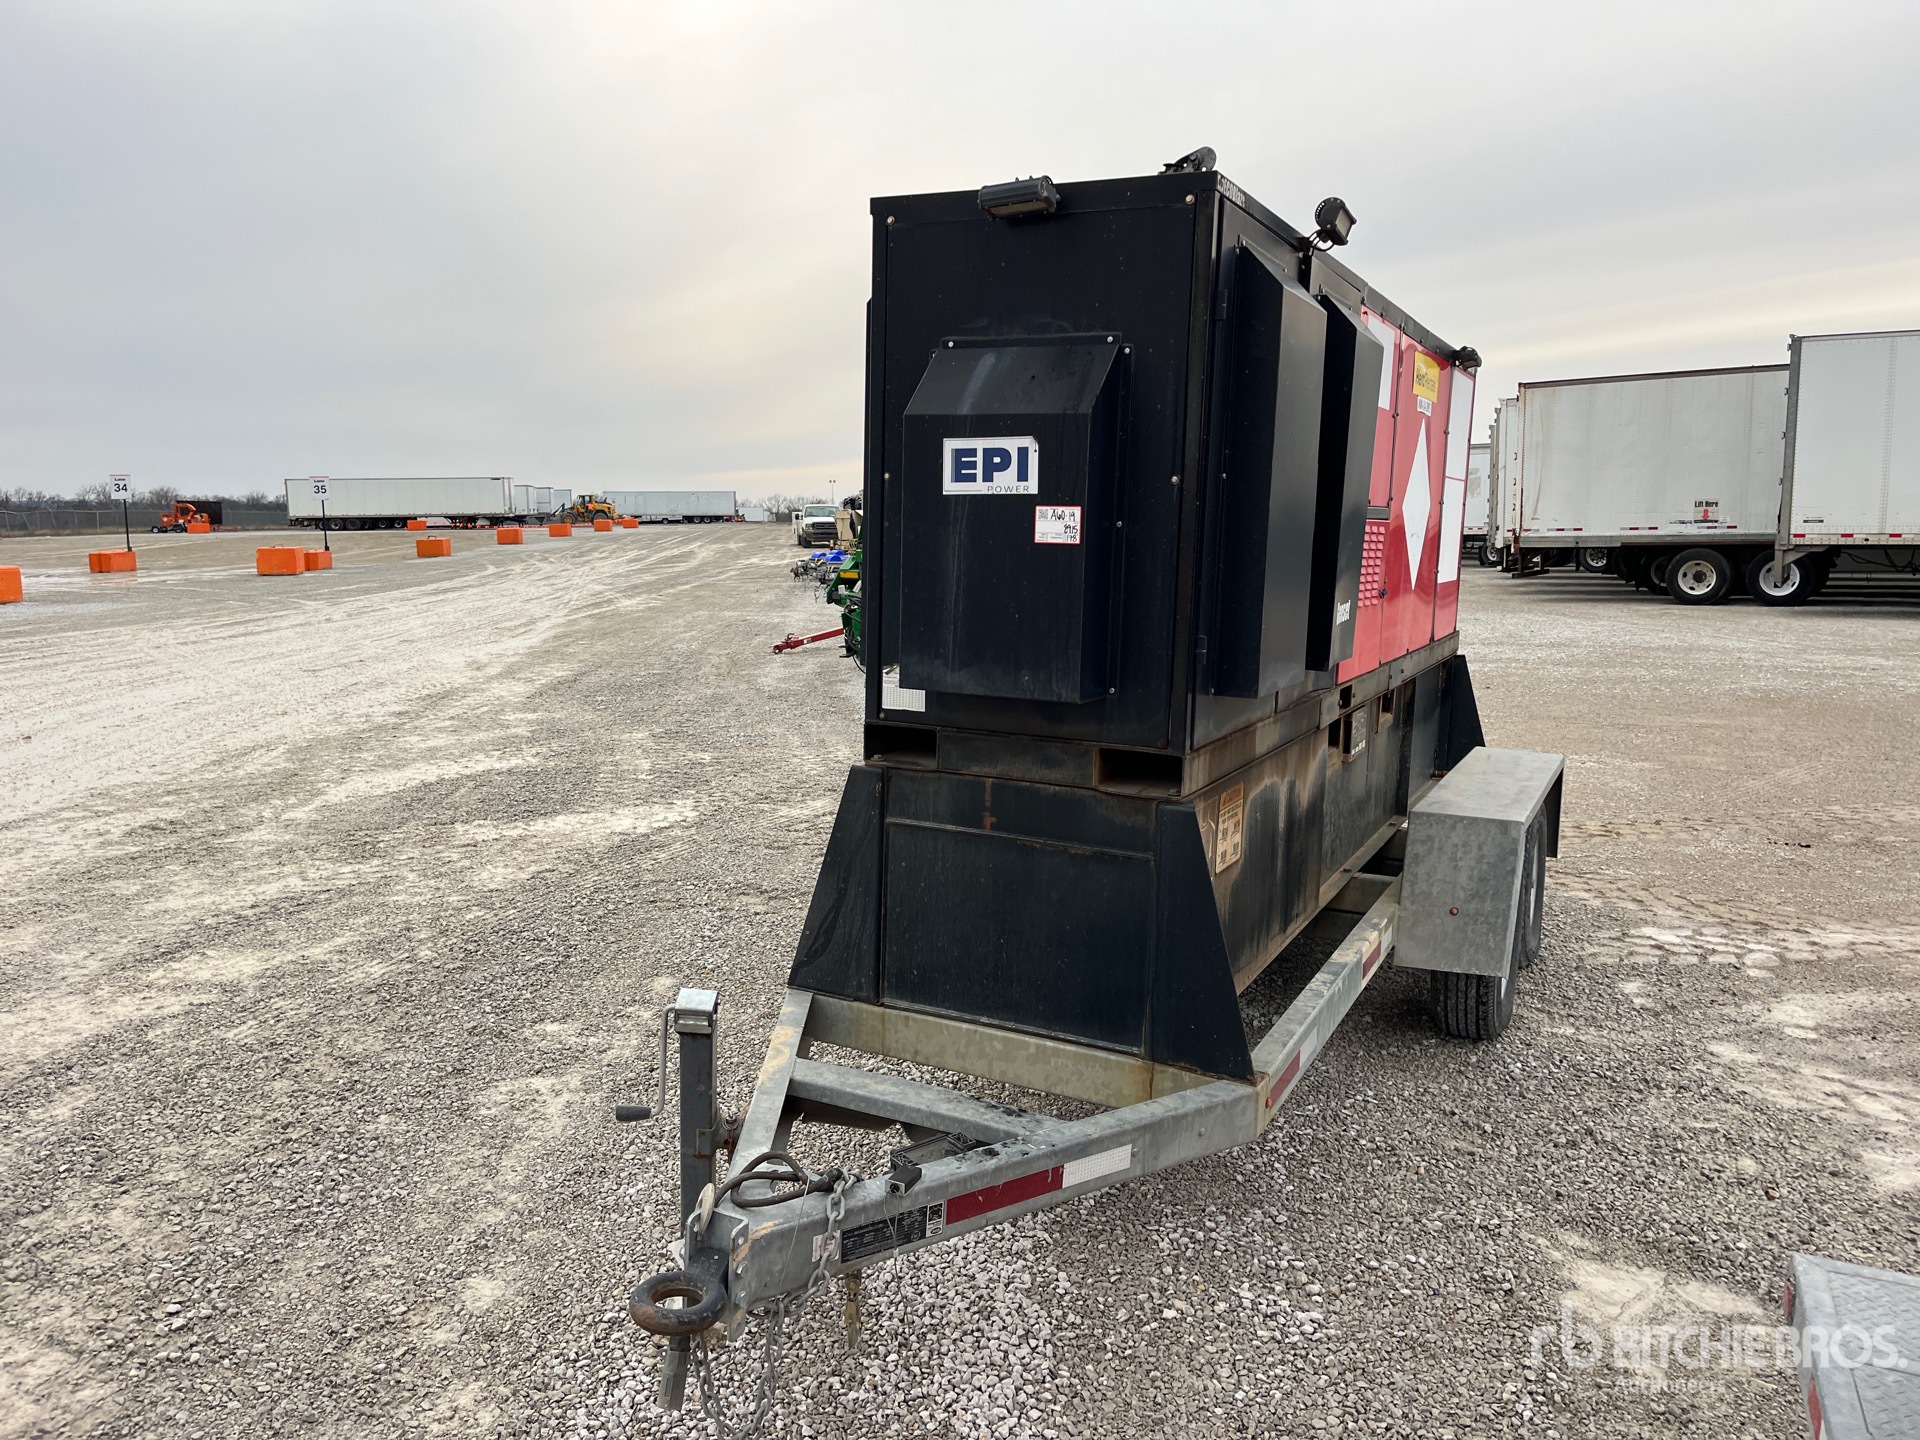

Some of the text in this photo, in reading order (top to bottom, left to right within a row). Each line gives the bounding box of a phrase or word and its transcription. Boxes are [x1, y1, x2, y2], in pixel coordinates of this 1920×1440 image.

[951, 447, 1029, 483] EPI
[114, 483, 128, 493] 34
[313, 485, 327, 494] 35
[987, 485, 1030, 493] POWER
[1694, 500, 1719, 508] Lift Here
